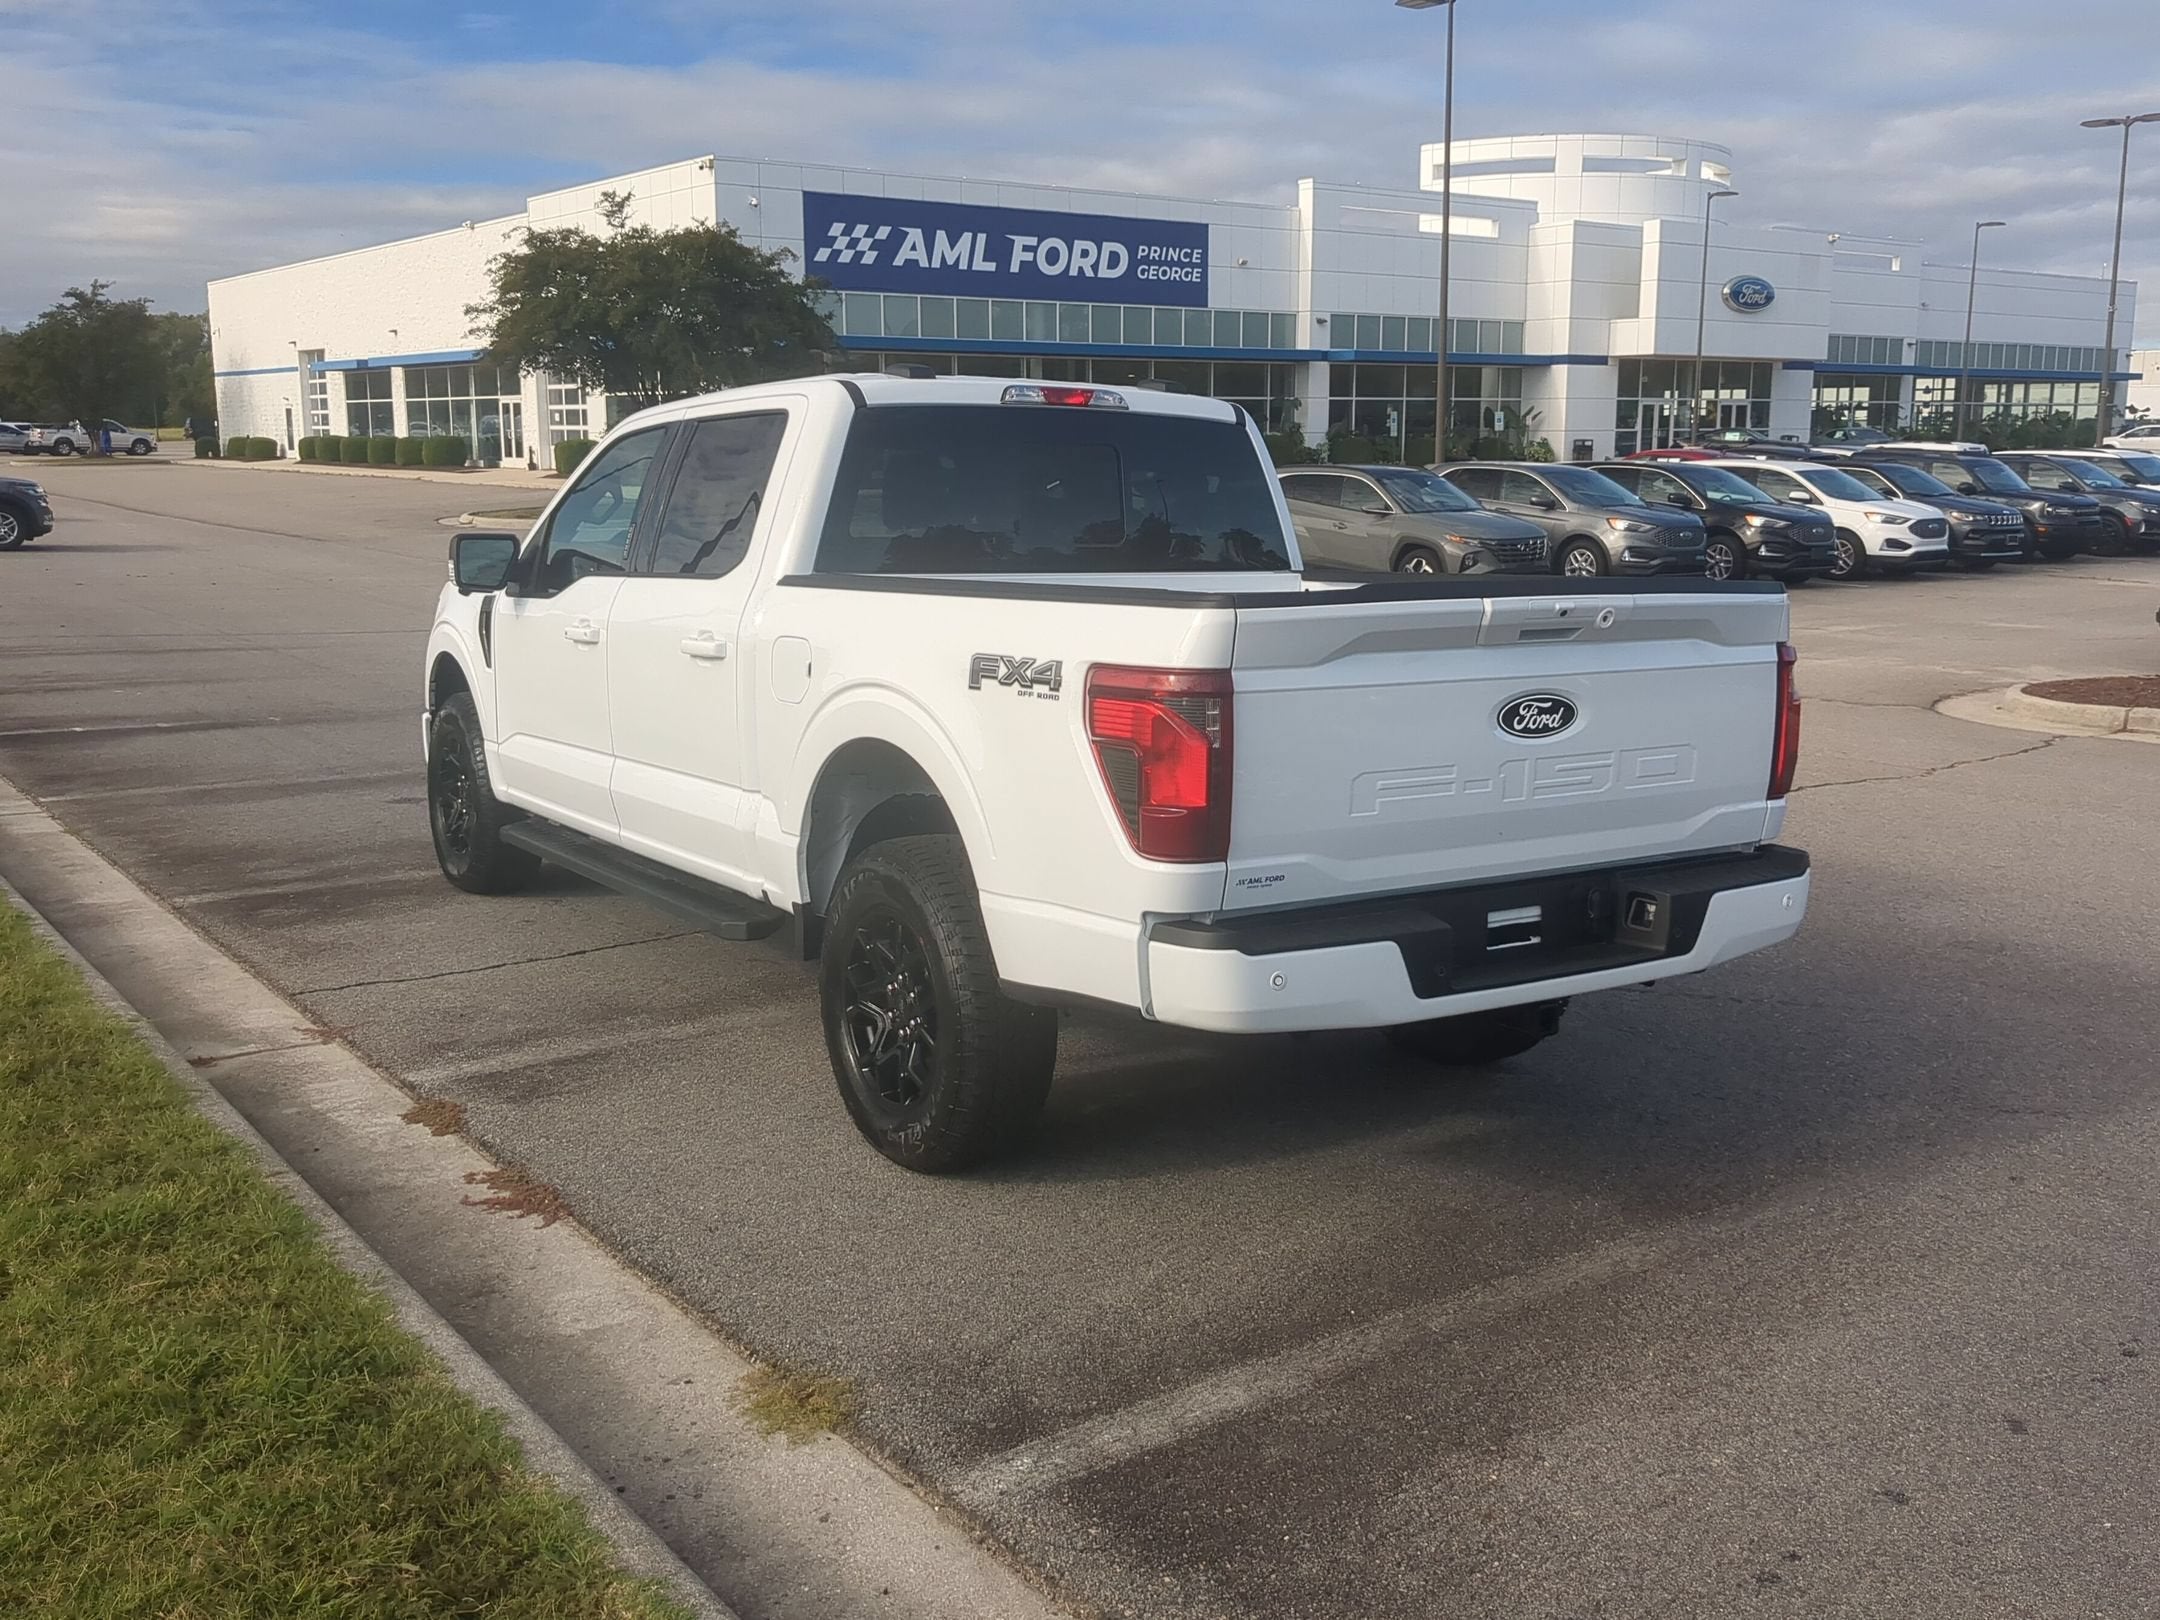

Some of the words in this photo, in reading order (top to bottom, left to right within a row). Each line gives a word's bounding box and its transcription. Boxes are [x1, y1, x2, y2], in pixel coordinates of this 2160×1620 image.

[892, 226, 997, 272] AML
[1004, 234, 1129, 279] FORD
[1137, 245, 1203, 263] PRINCE
[1137, 264, 1203, 282] GEORGE
[1738, 283, 1768, 304] Ford
[968, 653, 1063, 692] FX4
[1017, 690, 1035, 698] OFF
[1037, 692, 1060, 701] ROAD
[1513, 701, 1564, 730] Ford
[1350, 743, 1697, 816] F-150
[1264, 874, 1285, 883] FORD
